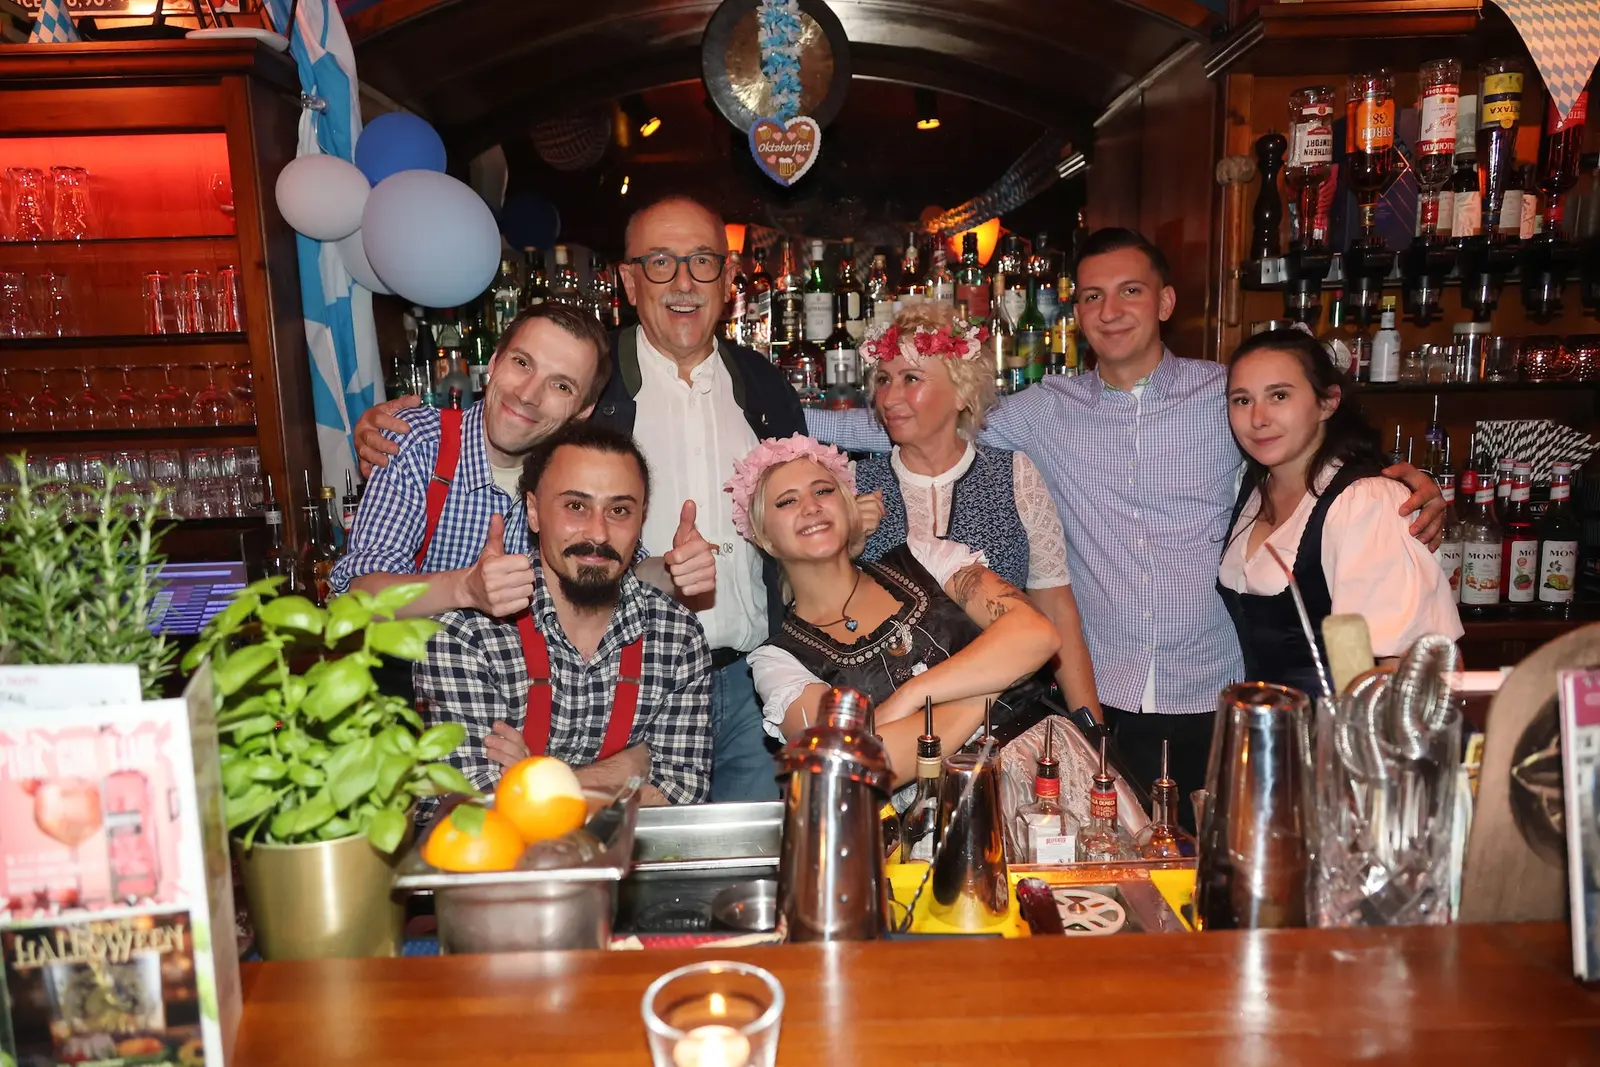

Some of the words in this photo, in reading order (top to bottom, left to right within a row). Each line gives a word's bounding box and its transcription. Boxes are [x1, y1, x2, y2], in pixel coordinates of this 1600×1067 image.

[1489, 106, 1518, 114] ETAXA
[758, 141, 811, 157] Oktoberfest
[12, 924, 185, 969] HALLOWEEN
